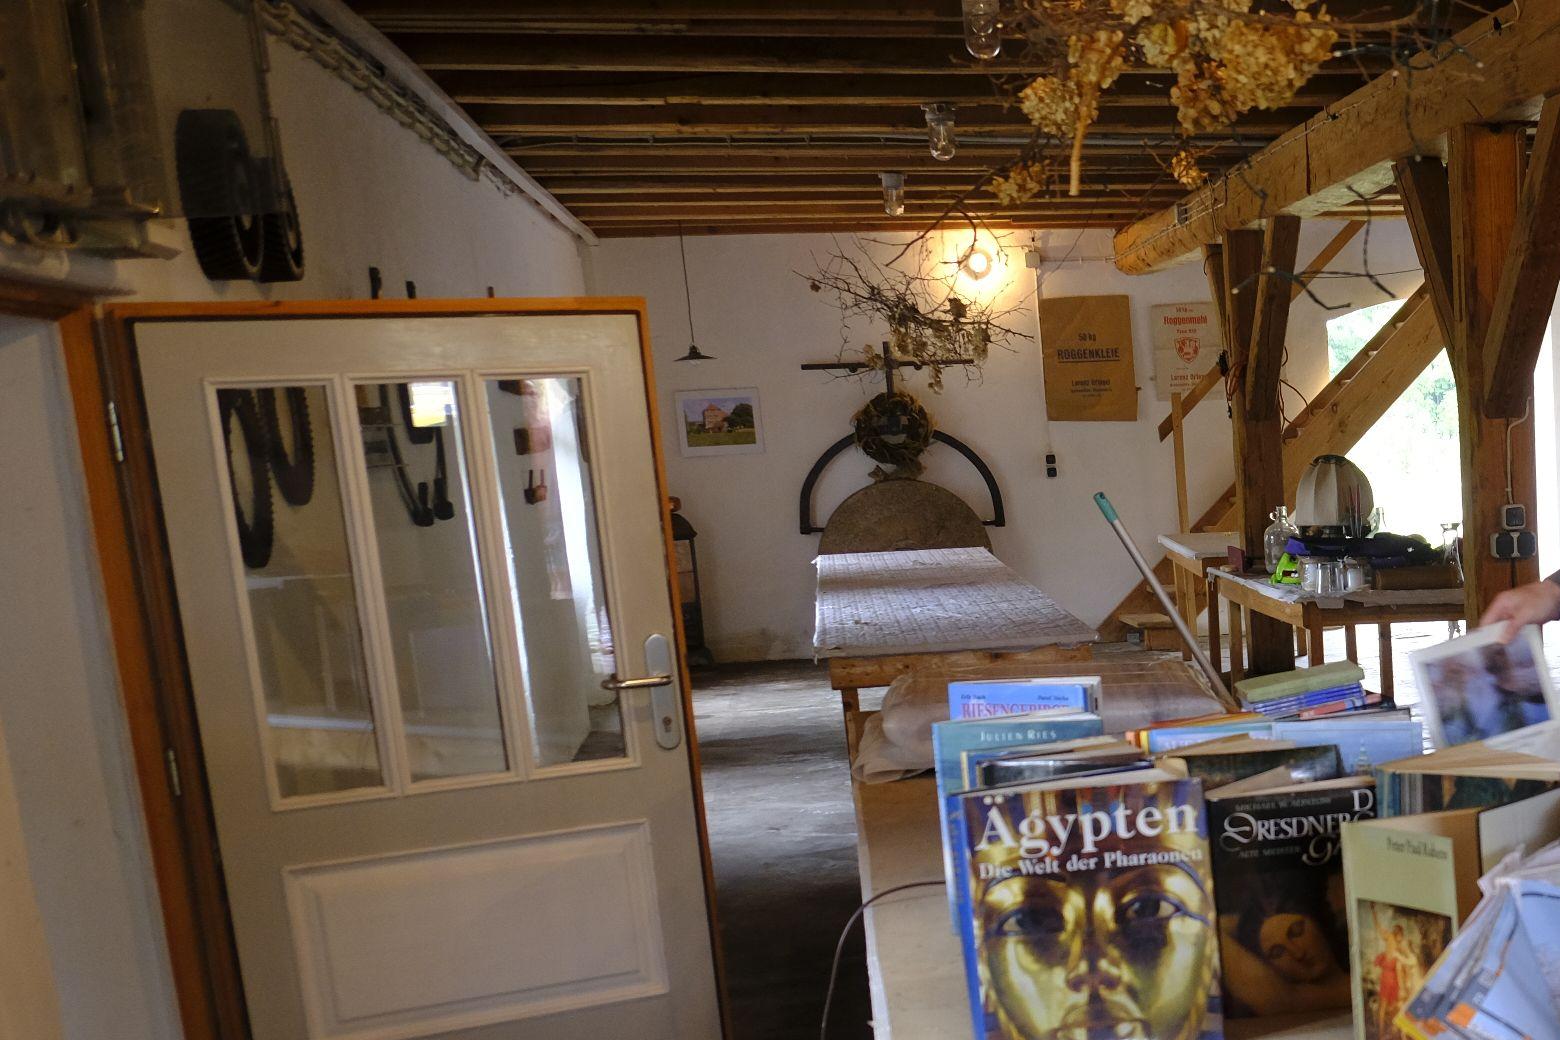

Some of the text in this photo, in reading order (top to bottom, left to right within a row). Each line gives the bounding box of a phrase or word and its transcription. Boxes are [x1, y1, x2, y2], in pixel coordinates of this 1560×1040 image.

[1057, 347, 1120, 360] ROGGENKLEIE
[974, 794, 1199, 859] Ägypten
[978, 846, 1205, 881] Die Welt der Pharaonen
